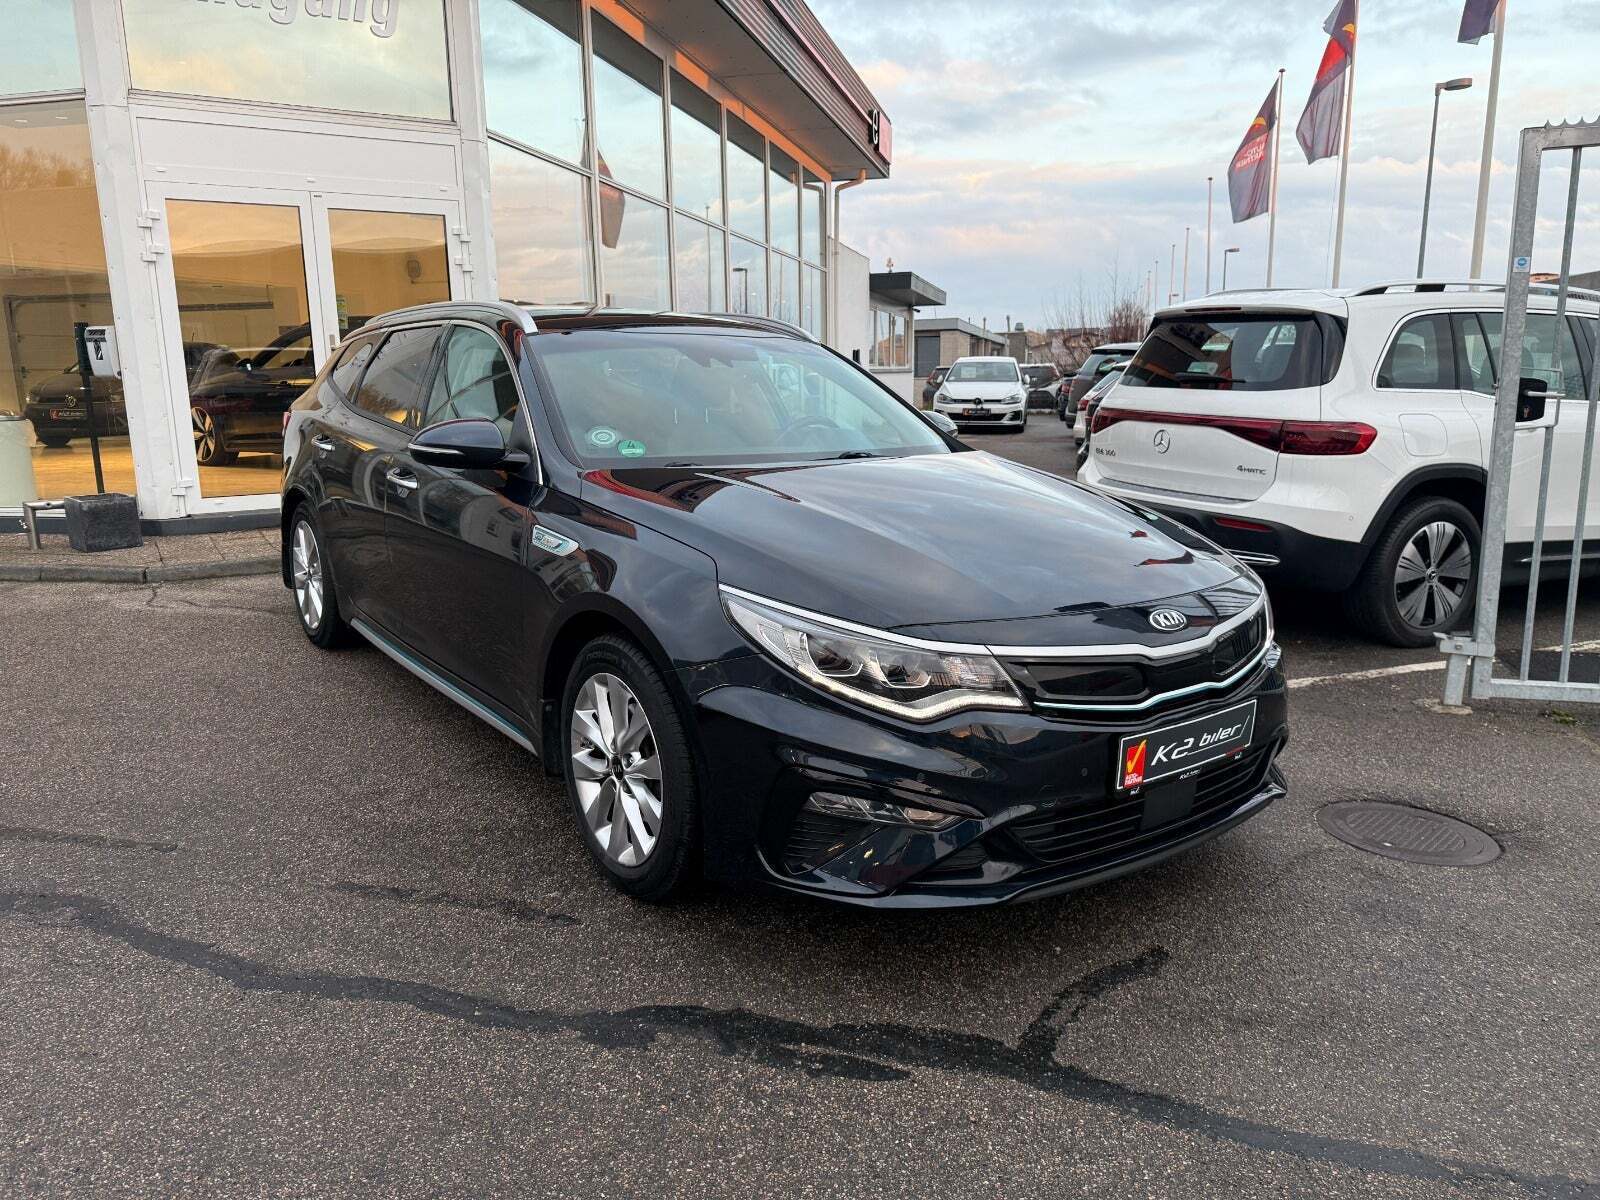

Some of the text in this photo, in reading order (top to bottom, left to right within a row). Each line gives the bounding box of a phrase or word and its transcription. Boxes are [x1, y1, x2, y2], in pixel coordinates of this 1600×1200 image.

[1153, 611, 1184, 628] KIA
[1151, 723, 1242, 766] K2 biler
